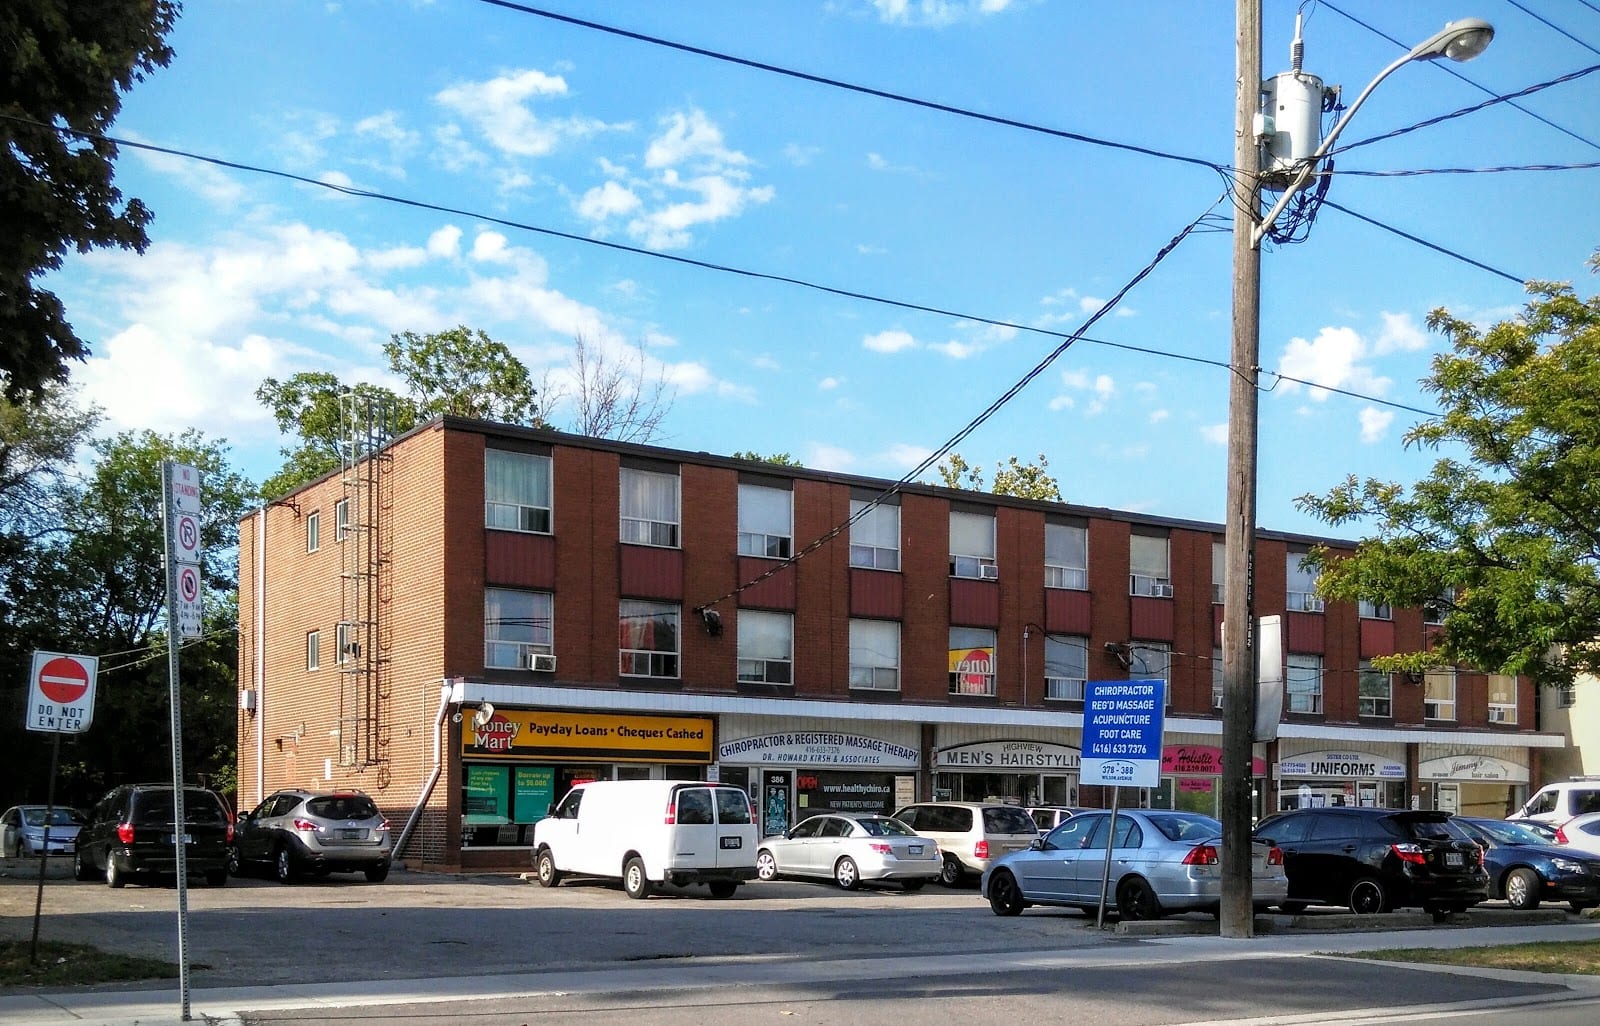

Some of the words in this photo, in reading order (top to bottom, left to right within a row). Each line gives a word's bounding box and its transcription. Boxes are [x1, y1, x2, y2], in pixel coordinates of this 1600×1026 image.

[182, 469, 190, 480] NO
[174, 482, 199, 498] STANDING
[1094, 686, 1154, 696] CHIROPRACTOR
[38, 704, 53, 715] DO
[62, 706, 85, 718] NOT
[1092, 700, 1115, 710] REG'D
[1116, 700, 1155, 710] MASSAGE
[39, 716, 81, 729] ENTER
[1093, 714, 1150, 724] ACUPUNCTURE
[471, 716, 522, 738] Money
[529, 722, 572, 736] Payday
[575, 724, 608, 736] Loans
[617, 726, 664, 740] Cheques
[666, 728, 704, 740] Cashed
[1099, 729, 1120, 739] FOOT
[1120, 730, 1142, 739] CARE
[474, 733, 513, 750] Mart
[720, 734, 786, 758] CHIROPRACTOR
[786, 734, 794, 745] &
[795, 734, 844, 746] REGISTERED
[845, 735, 882, 752] MASSAGE
[883, 743, 919, 762] THERAPY
[1002, 743, 1043, 753] HIGHVIEW
[1092, 743, 1112, 754] (416)
[1113, 745, 1127, 754] 633
[1128, 745, 1147, 754] 7376
[762, 753, 775, 761] DR.
[778, 754, 808, 762] HOWARD
[810, 754, 831, 762] KIRSH
[840, 755, 880, 764] ASSOCIATES
[947, 750, 994, 765] MEN'S
[1178, 748, 1212, 764] Holistic
[1102, 766, 1115, 774] 378
[1120, 766, 1134, 775] 388
[1311, 762, 1376, 776] UNIFORMS
[1450, 756, 1484, 776] Jimmy's
[770, 776, 784, 784] 386
[796, 775, 819, 789] OPEN
[823, 784, 891, 795] www.healthychiro.ca
[829, 800, 842, 809] NEW
[842, 800, 862, 809] PATIENTS
[862, 800, 884, 809] WELCOME
